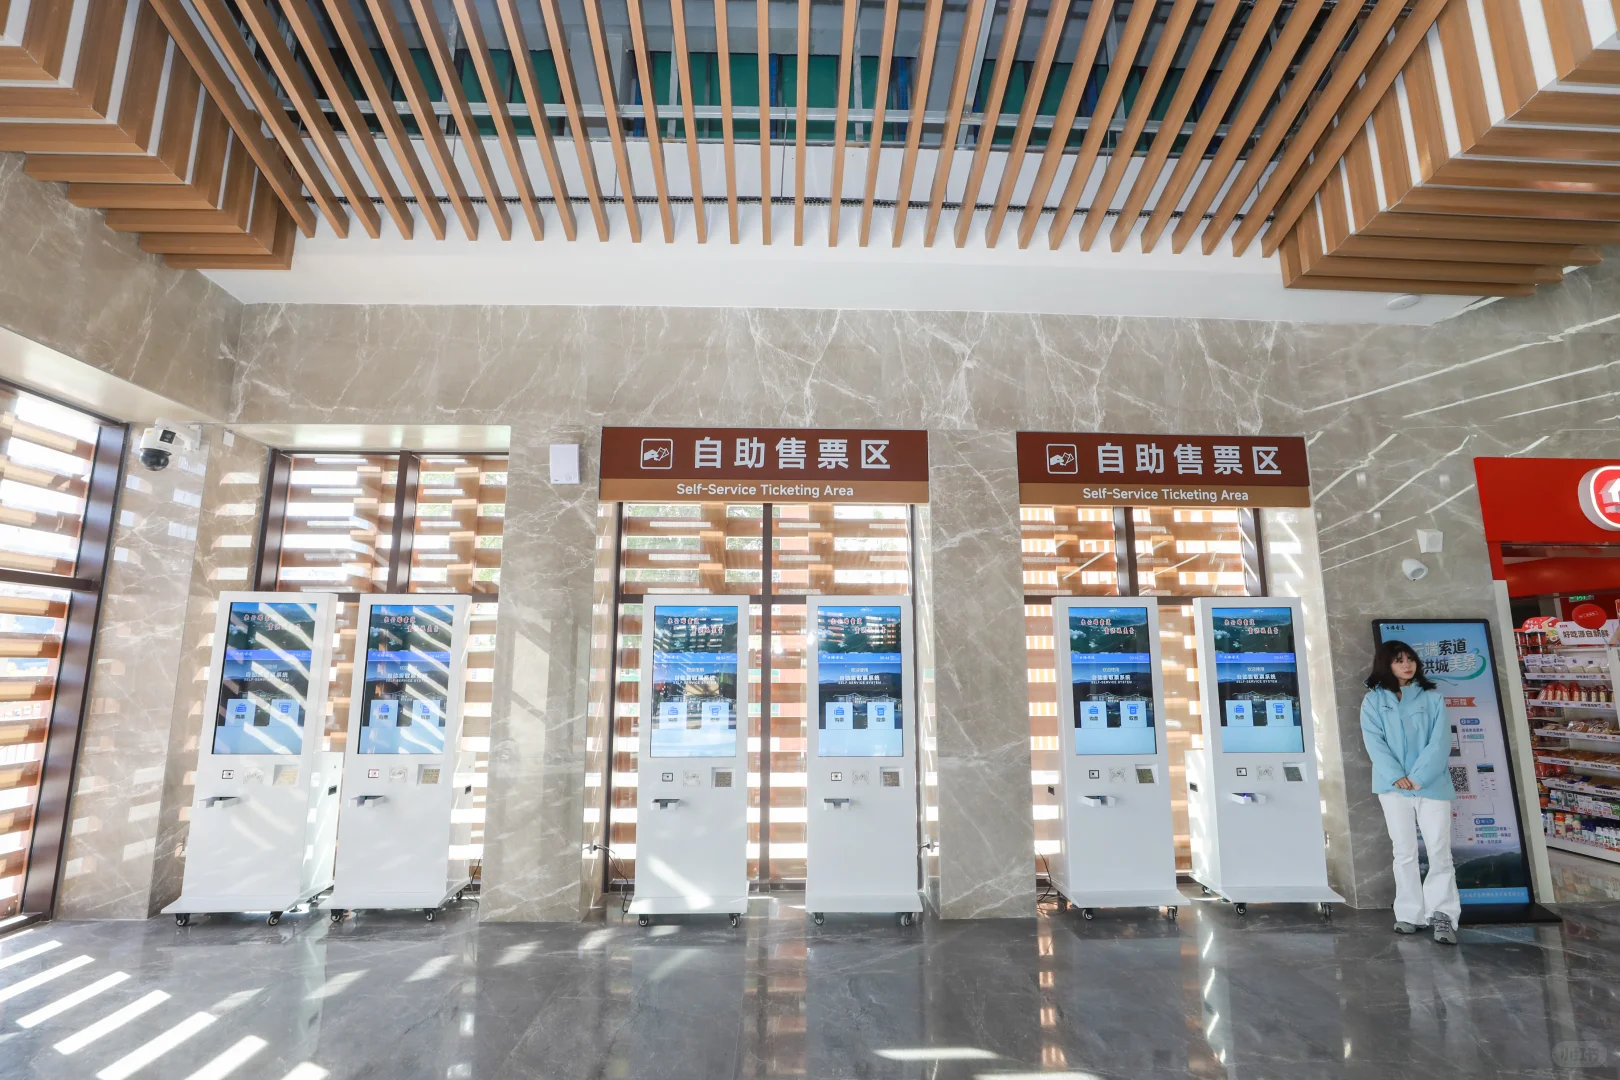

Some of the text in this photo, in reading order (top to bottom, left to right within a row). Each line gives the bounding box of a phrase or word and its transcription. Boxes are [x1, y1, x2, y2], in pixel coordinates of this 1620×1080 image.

[694, 436, 890, 470] 自助售票区
[1097, 442, 1282, 475] 自助售票区
[676, 483, 854, 498] Self-Service Ticketing Area
[1083, 488, 1248, 502] Self-Service Ticketing Area
